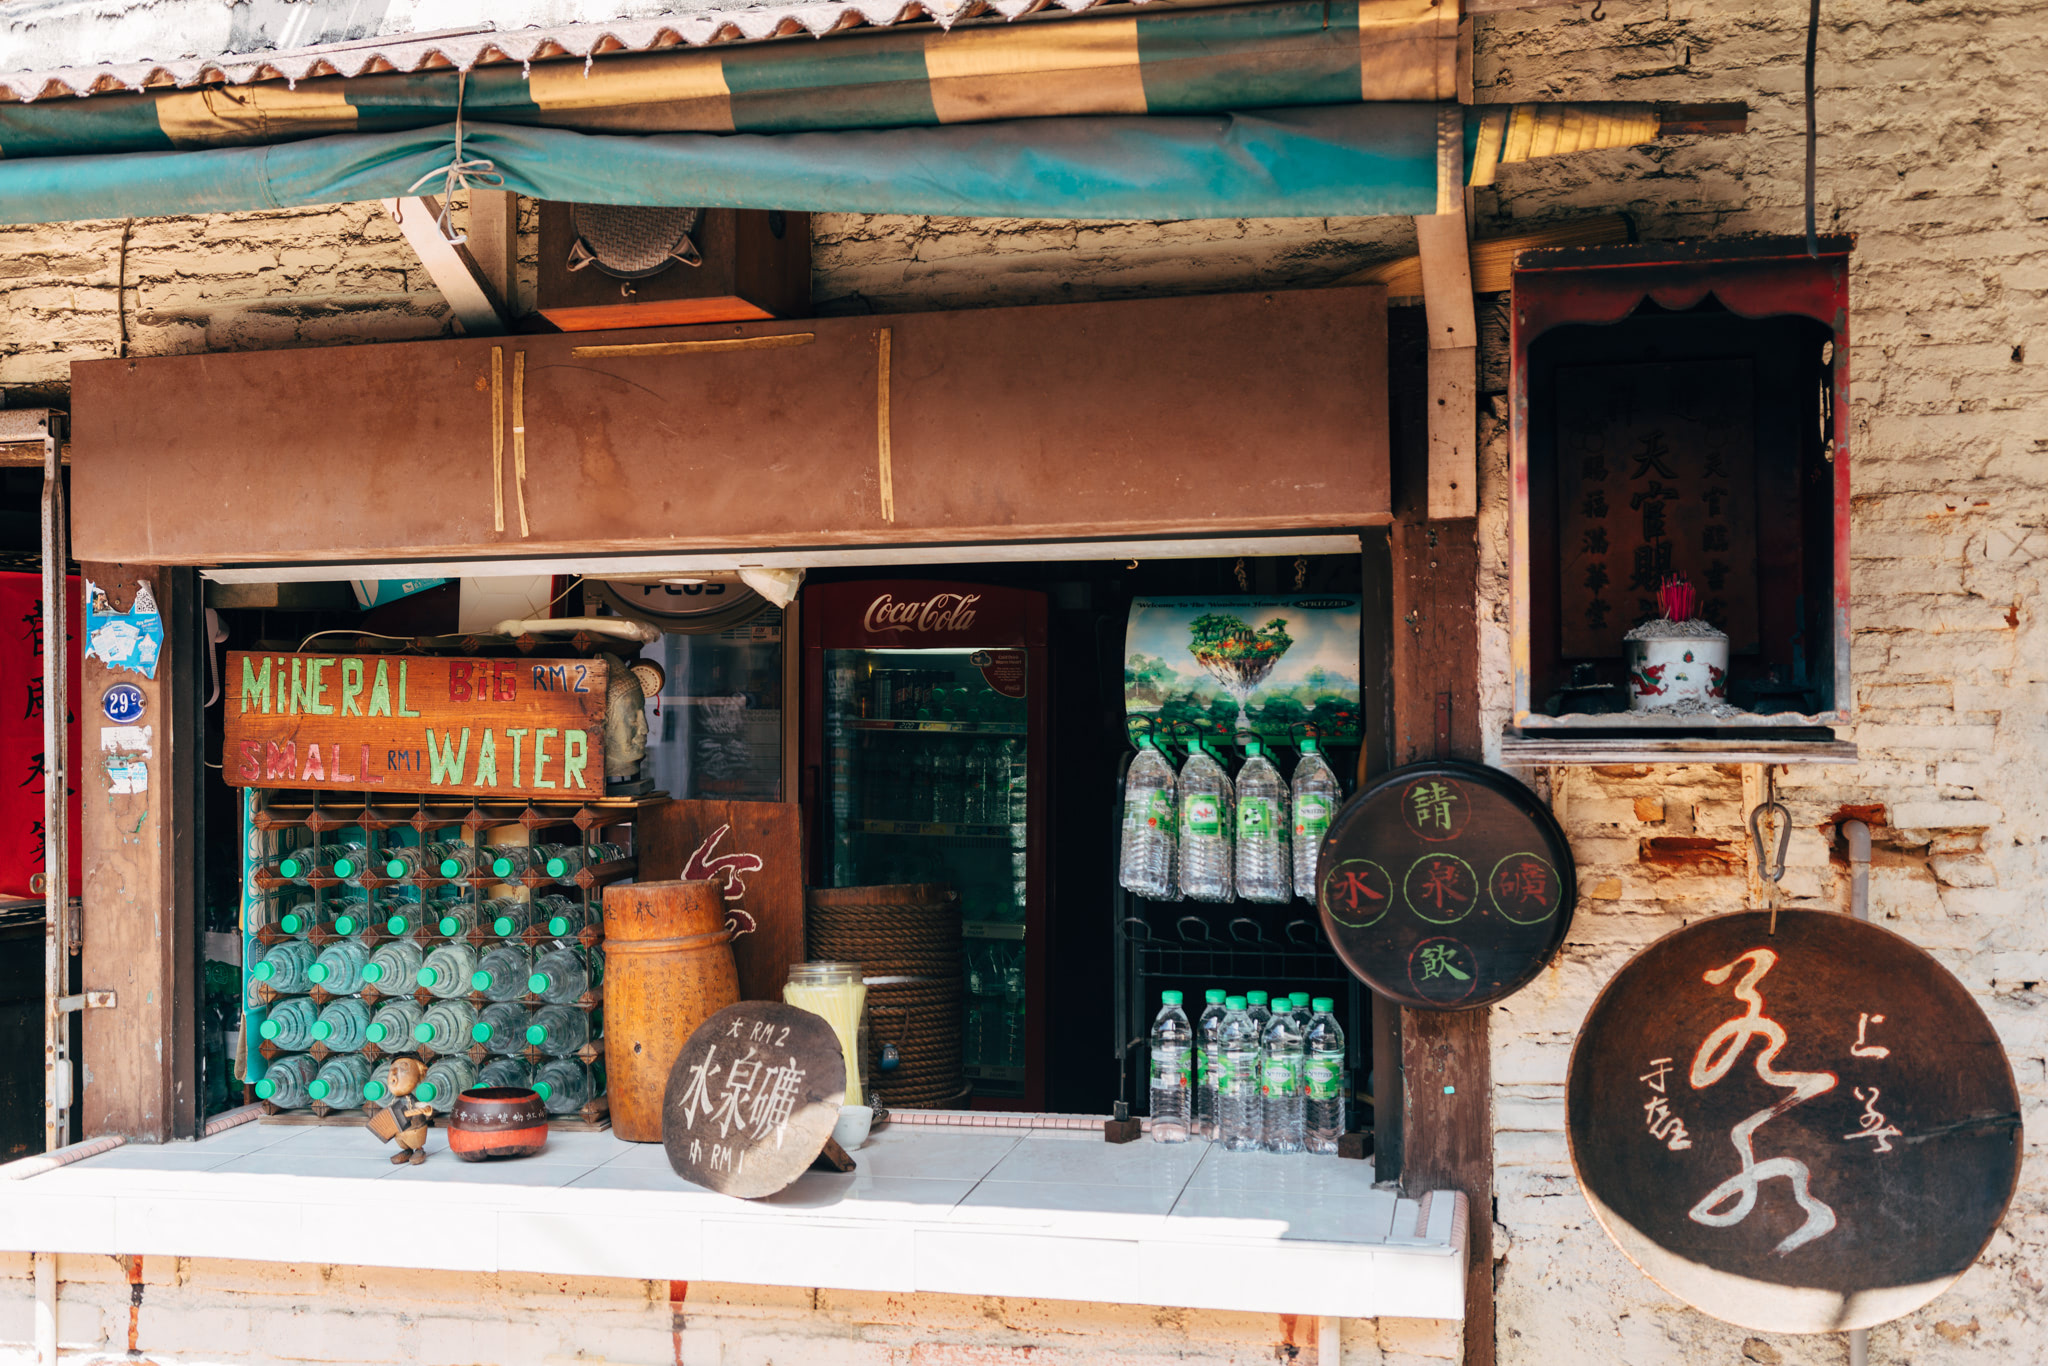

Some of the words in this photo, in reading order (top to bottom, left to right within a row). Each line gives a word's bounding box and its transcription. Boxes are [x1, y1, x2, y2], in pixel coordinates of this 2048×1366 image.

[863, 593, 981, 633] Coca-Cola
[1299, 600, 1348, 608] SPRITZER
[239, 739, 385, 783] SMALL
[425, 726, 588, 789] WATER
[726, 1016, 743, 1038] 大
